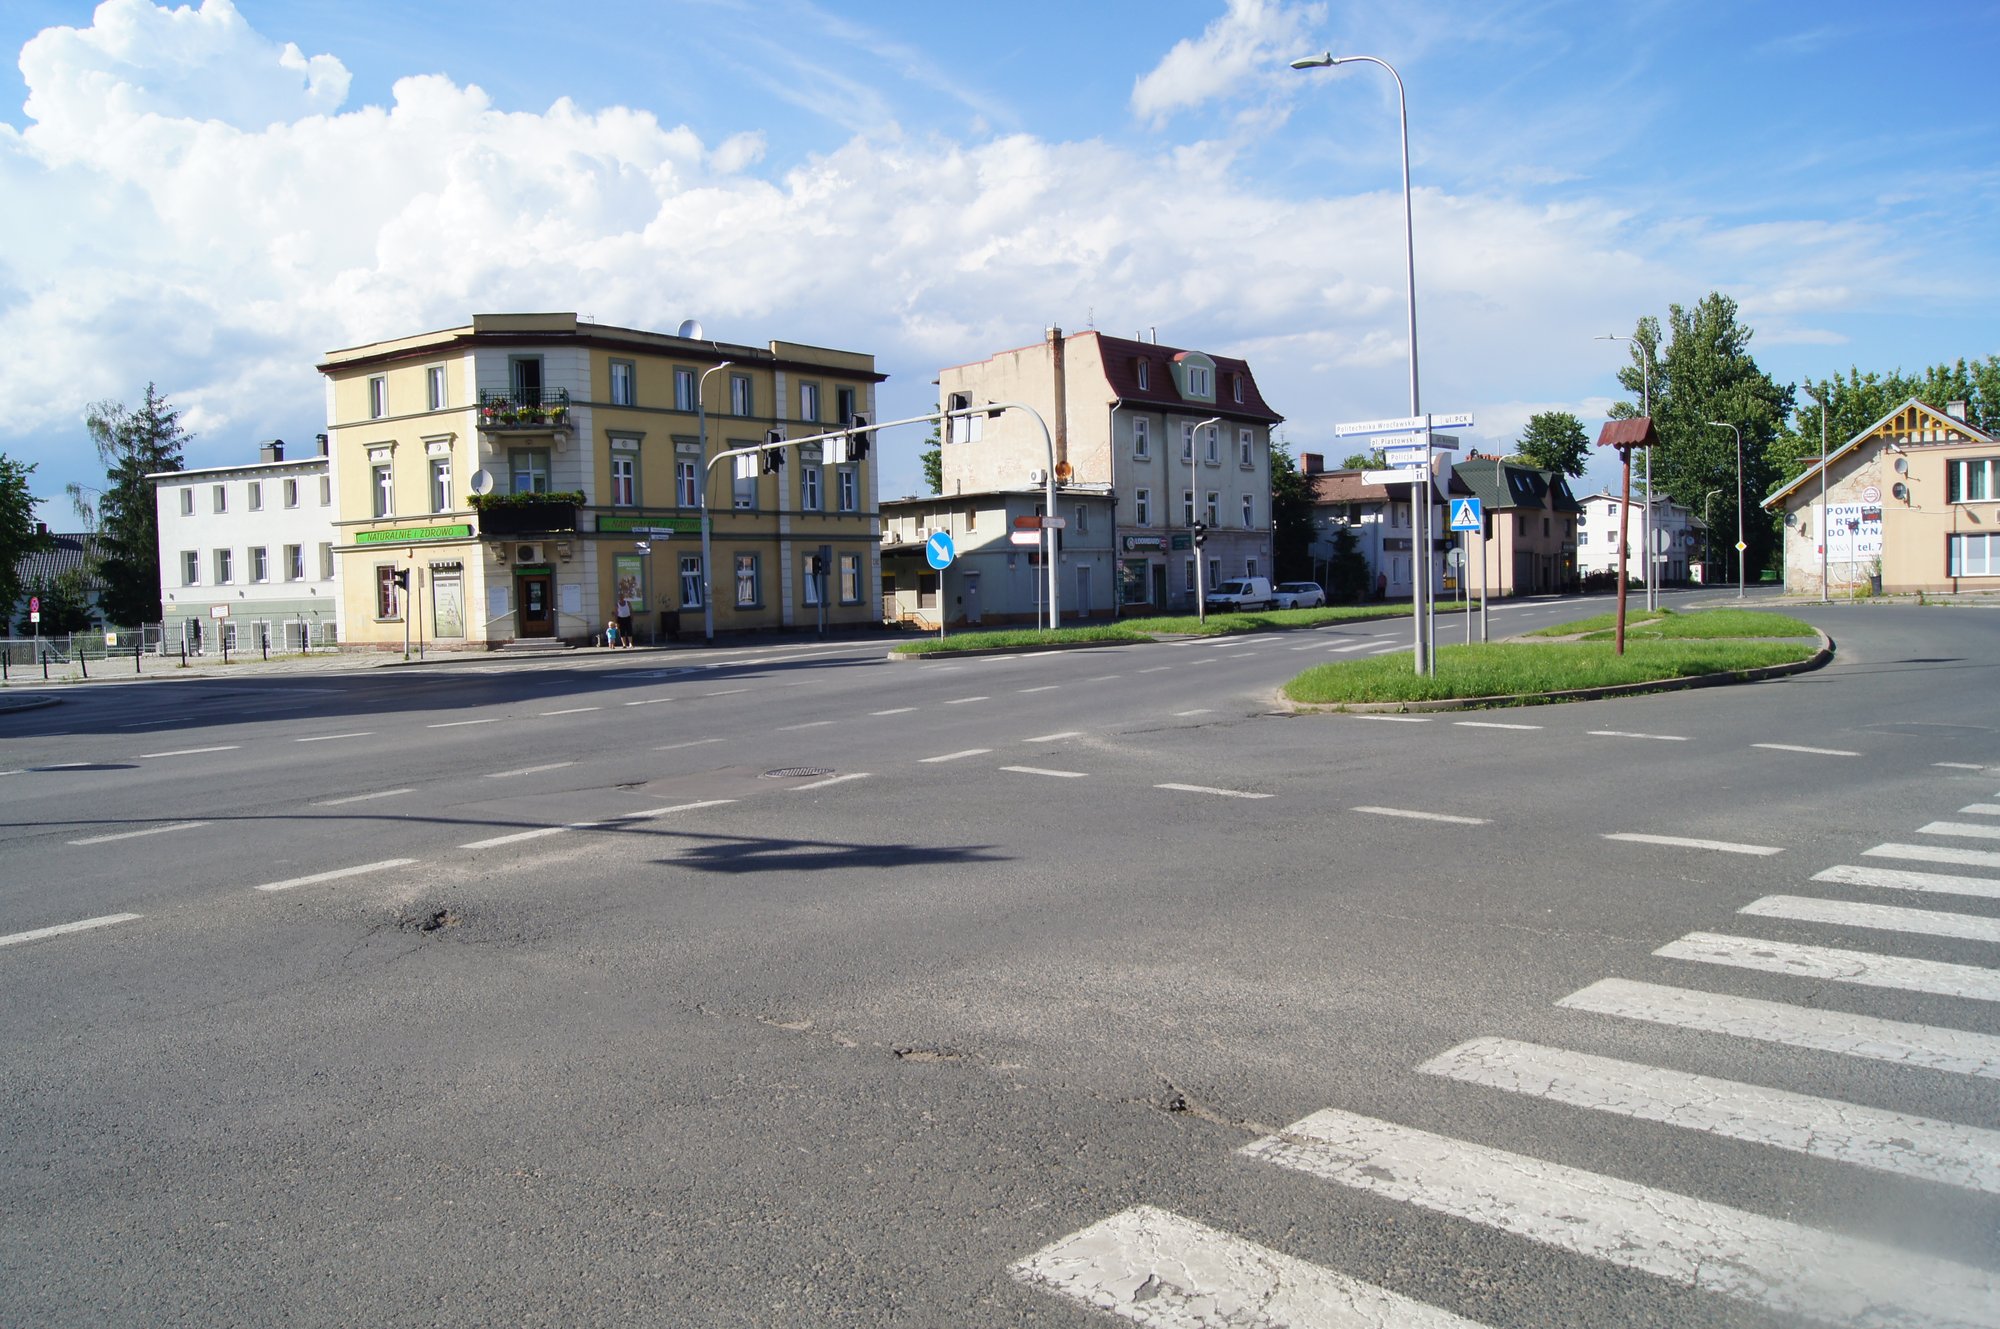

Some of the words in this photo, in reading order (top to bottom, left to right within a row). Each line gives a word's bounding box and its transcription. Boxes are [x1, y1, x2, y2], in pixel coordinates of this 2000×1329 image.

[1337, 423, 1376, 432] Politechnika
[1377, 421, 1415, 429] Wrocławska
[1381, 436, 1416, 445] Piastowski
[1391, 453, 1413, 461] Policja
[1836, 517, 1882, 526] REKLA
[367, 531, 412, 541] NATURALNIE
[420, 528, 454, 538] ZDROWO
[1828, 529, 1845, 537] DO
[1851, 527, 1882, 536] WYN
[1858, 543, 1874, 552] tel.
